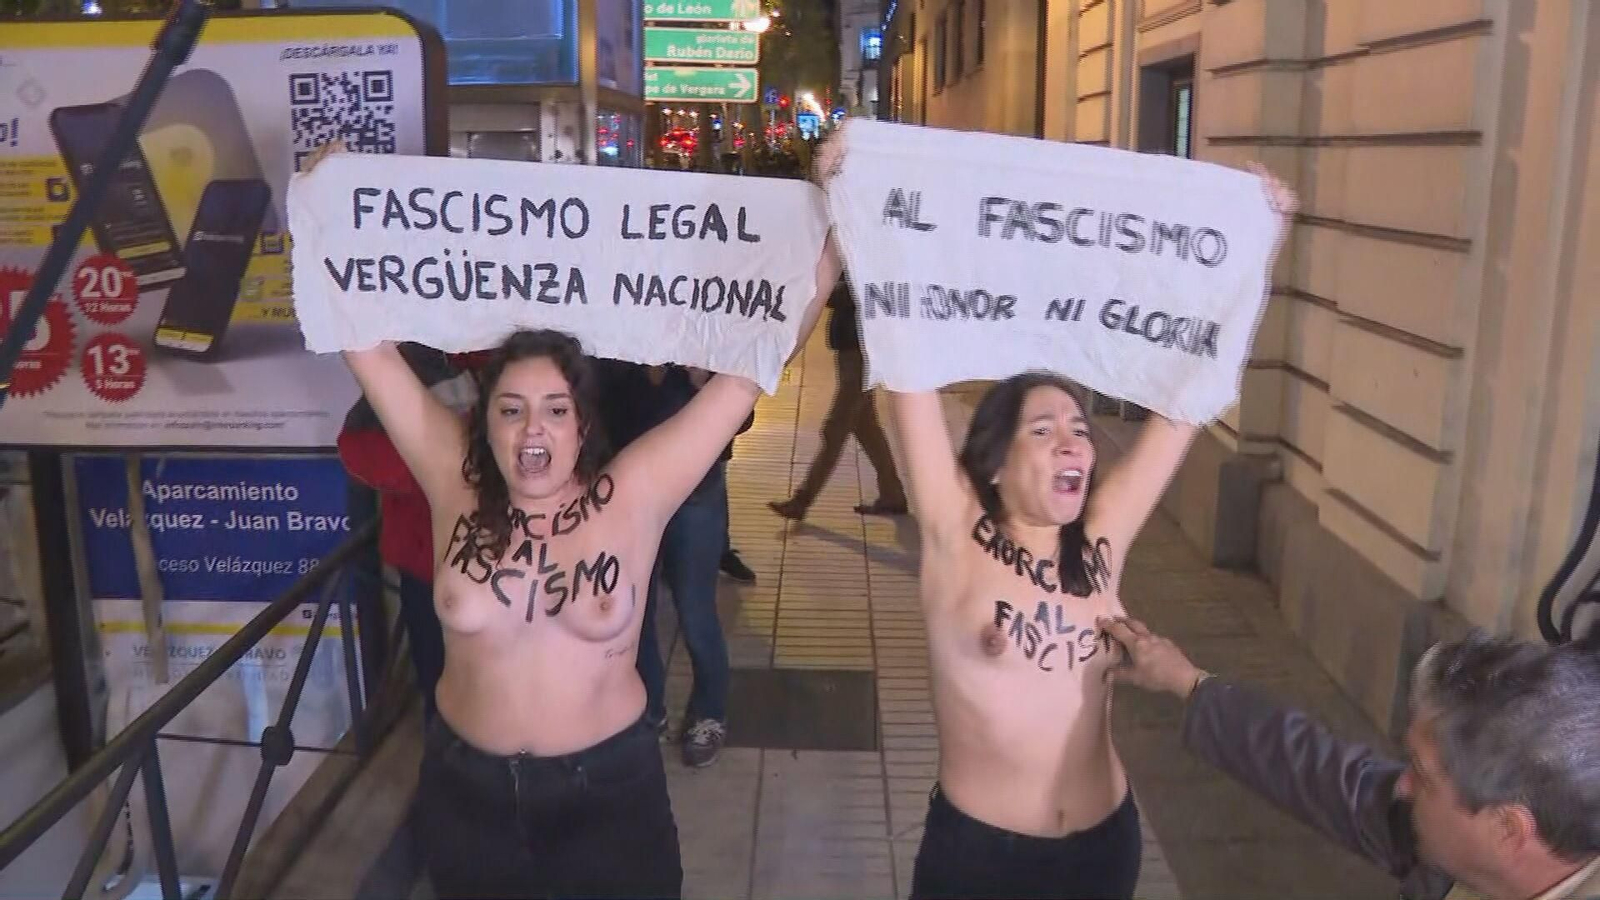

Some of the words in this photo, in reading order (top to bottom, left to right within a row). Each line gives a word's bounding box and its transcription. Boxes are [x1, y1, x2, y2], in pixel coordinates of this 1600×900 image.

[656, 3, 674, 14] de
[677, 3, 712, 14] León
[667, 45, 712, 58] Rubén
[662, 83, 678, 94] de
[680, 84, 725, 96] Vergara
[353, 187, 590, 239] FASCISMO
[621, 203, 762, 243] LEGAL
[882, 187, 939, 232] AL
[977, 195, 1229, 268] FASCISMO
[78, 266, 123, 298] 20
[325, 248, 588, 304] VERGÜENZA
[613, 272, 788, 322] NACIONAL
[1044, 297, 1087, 321] NI
[88, 344, 130, 375] 13
[142, 480, 299, 503] Aparcamiento
[225, 510, 280, 530] Juan
[204, 556, 293, 578] Velázquez
[512, 539, 559, 575] AL
[1034, 601, 1076, 635] AL
